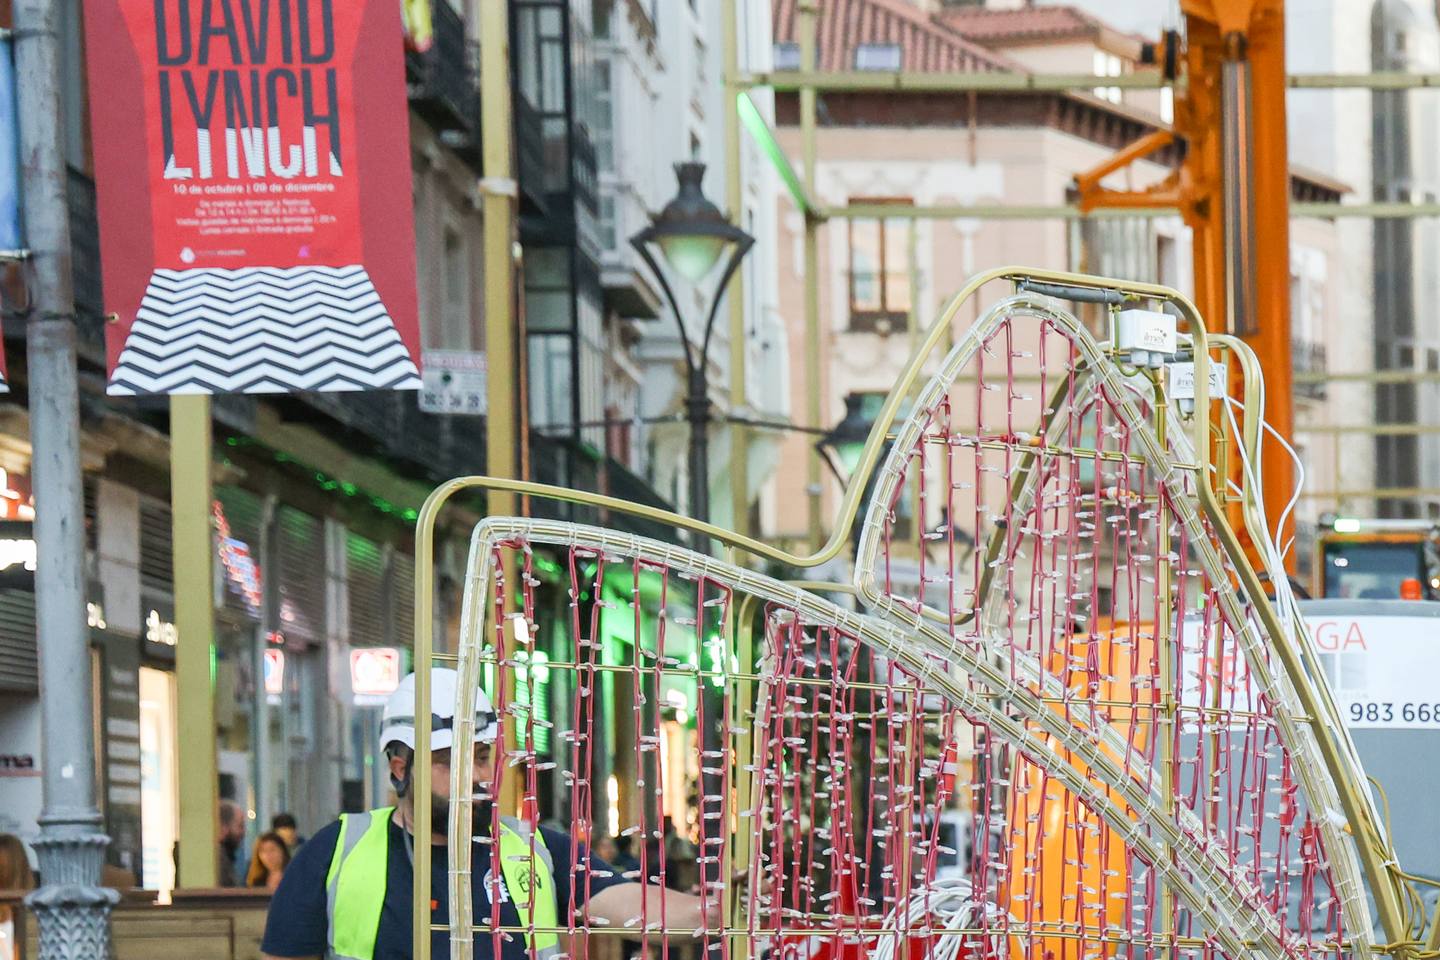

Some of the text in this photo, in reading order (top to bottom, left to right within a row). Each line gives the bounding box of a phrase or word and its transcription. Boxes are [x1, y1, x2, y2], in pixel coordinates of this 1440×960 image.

[154, 0, 335, 65] DAVID
[159, 68, 343, 179] LYNCH
[173, 184, 187, 194] 10
[189, 184, 202, 194] de
[204, 184, 243, 194] octubre
[269, 183, 282, 193] de
[285, 182, 335, 193] diciembre
[1305, 622, 1367, 651] GA
[1350, 702, 1394, 722] 983
